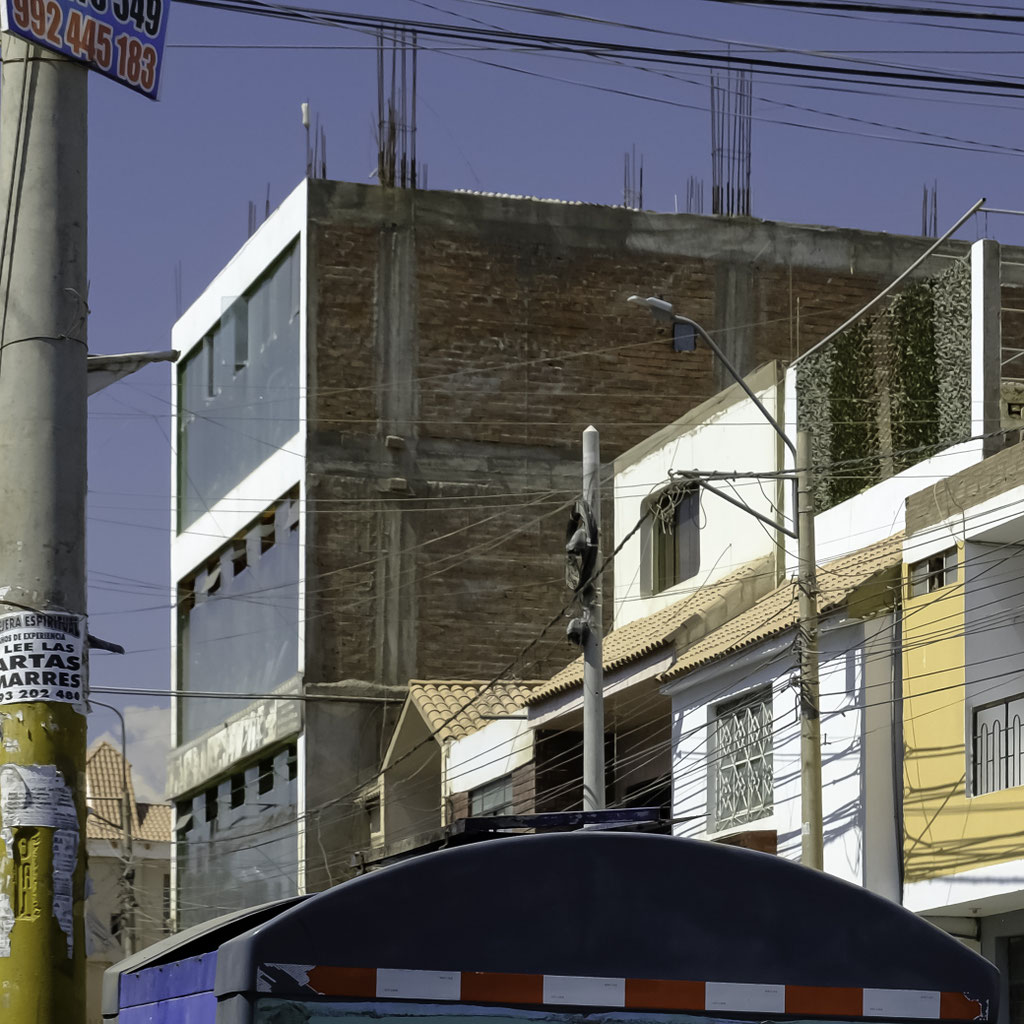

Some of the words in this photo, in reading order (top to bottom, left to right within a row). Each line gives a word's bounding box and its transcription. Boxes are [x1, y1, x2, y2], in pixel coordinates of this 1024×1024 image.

[13, 0, 61, 45] 992
[67, 12, 112, 69] 445
[117, 35, 157, 89] 183
[25, 614, 80, 638] ESPIRI
[13, 633, 21, 641] DE
[4, 642, 33, 653] LEE
[42, 642, 75, 653] LAS
[19, 689, 49, 698] 202
